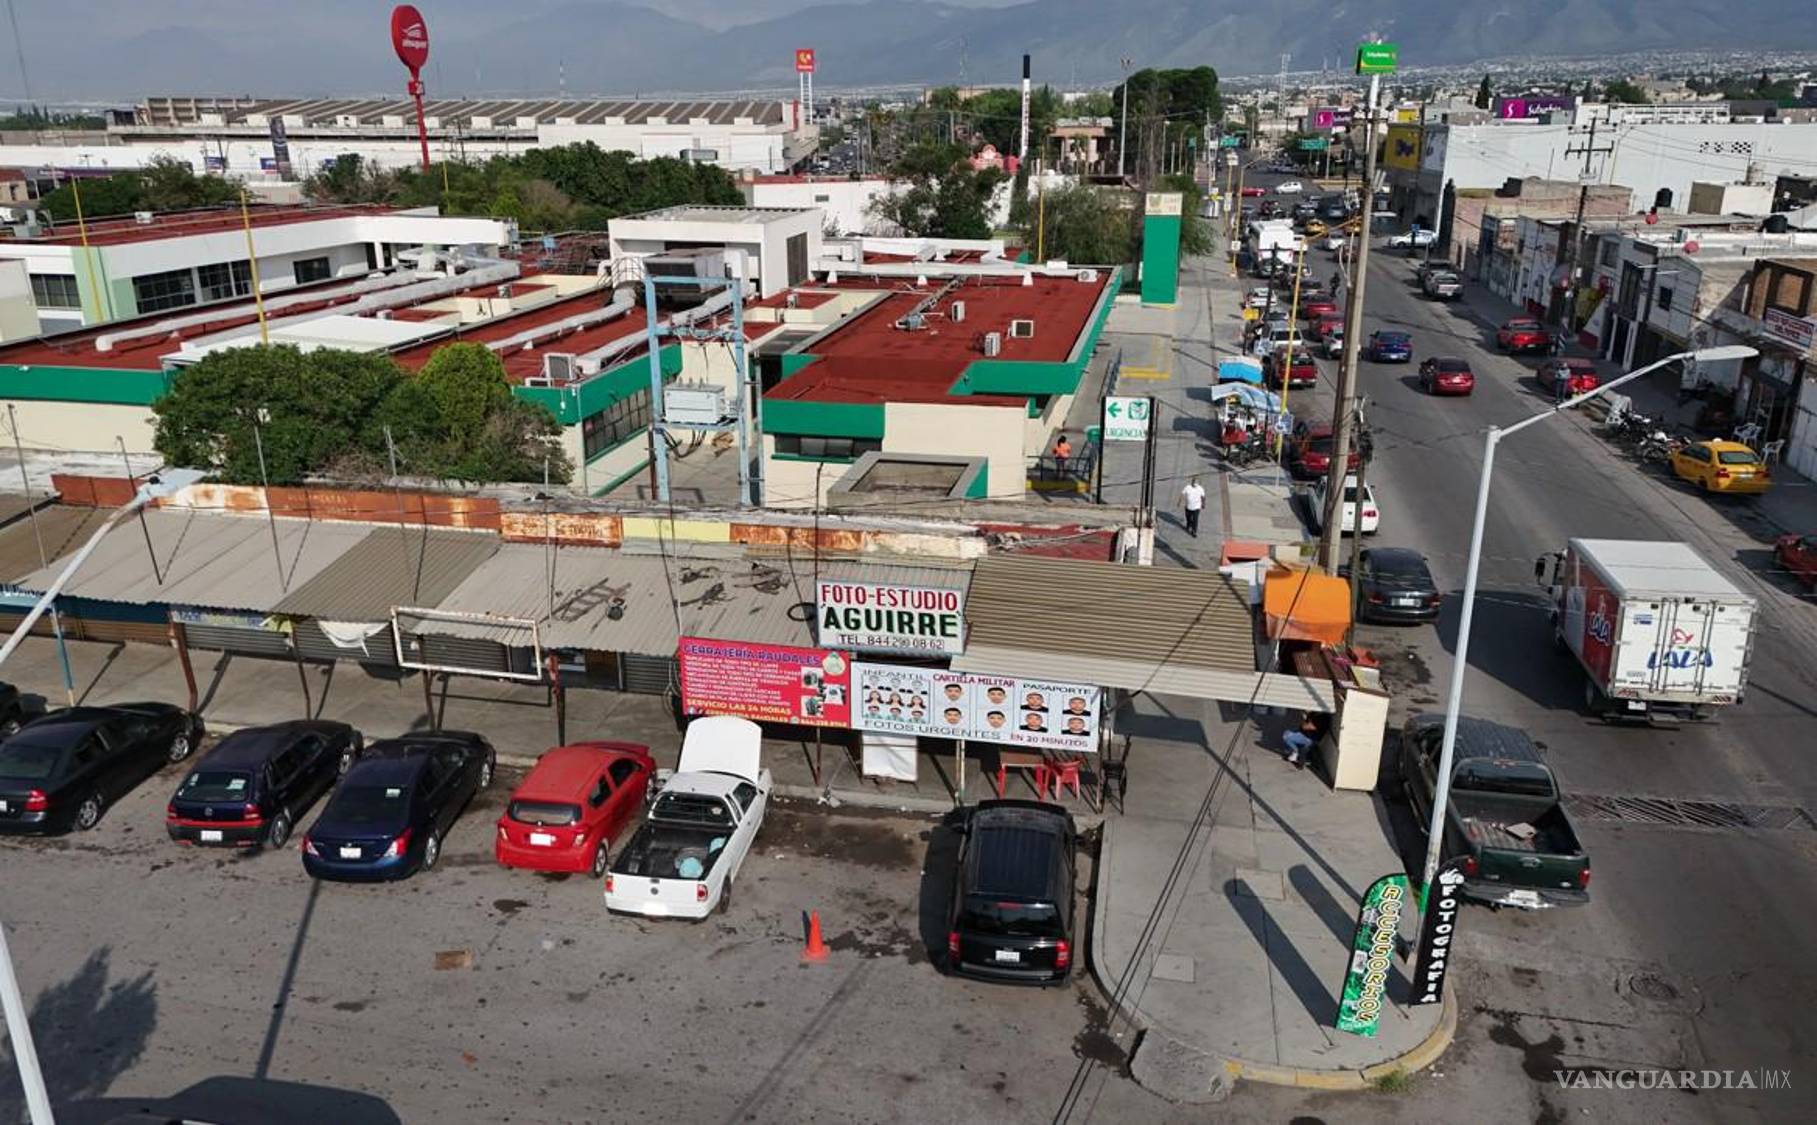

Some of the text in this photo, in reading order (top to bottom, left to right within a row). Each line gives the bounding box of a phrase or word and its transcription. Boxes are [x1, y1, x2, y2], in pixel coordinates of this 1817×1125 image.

[821, 584, 958, 611] FOTO-ESTUDIO
[933, 673, 1015, 688] CARTILLA MILITAR
[1023, 683, 1091, 695] PASAPORTE
[864, 720, 1001, 740] FOTOS URGENTES
[1354, 884, 1402, 1023] ACCESORIOS
